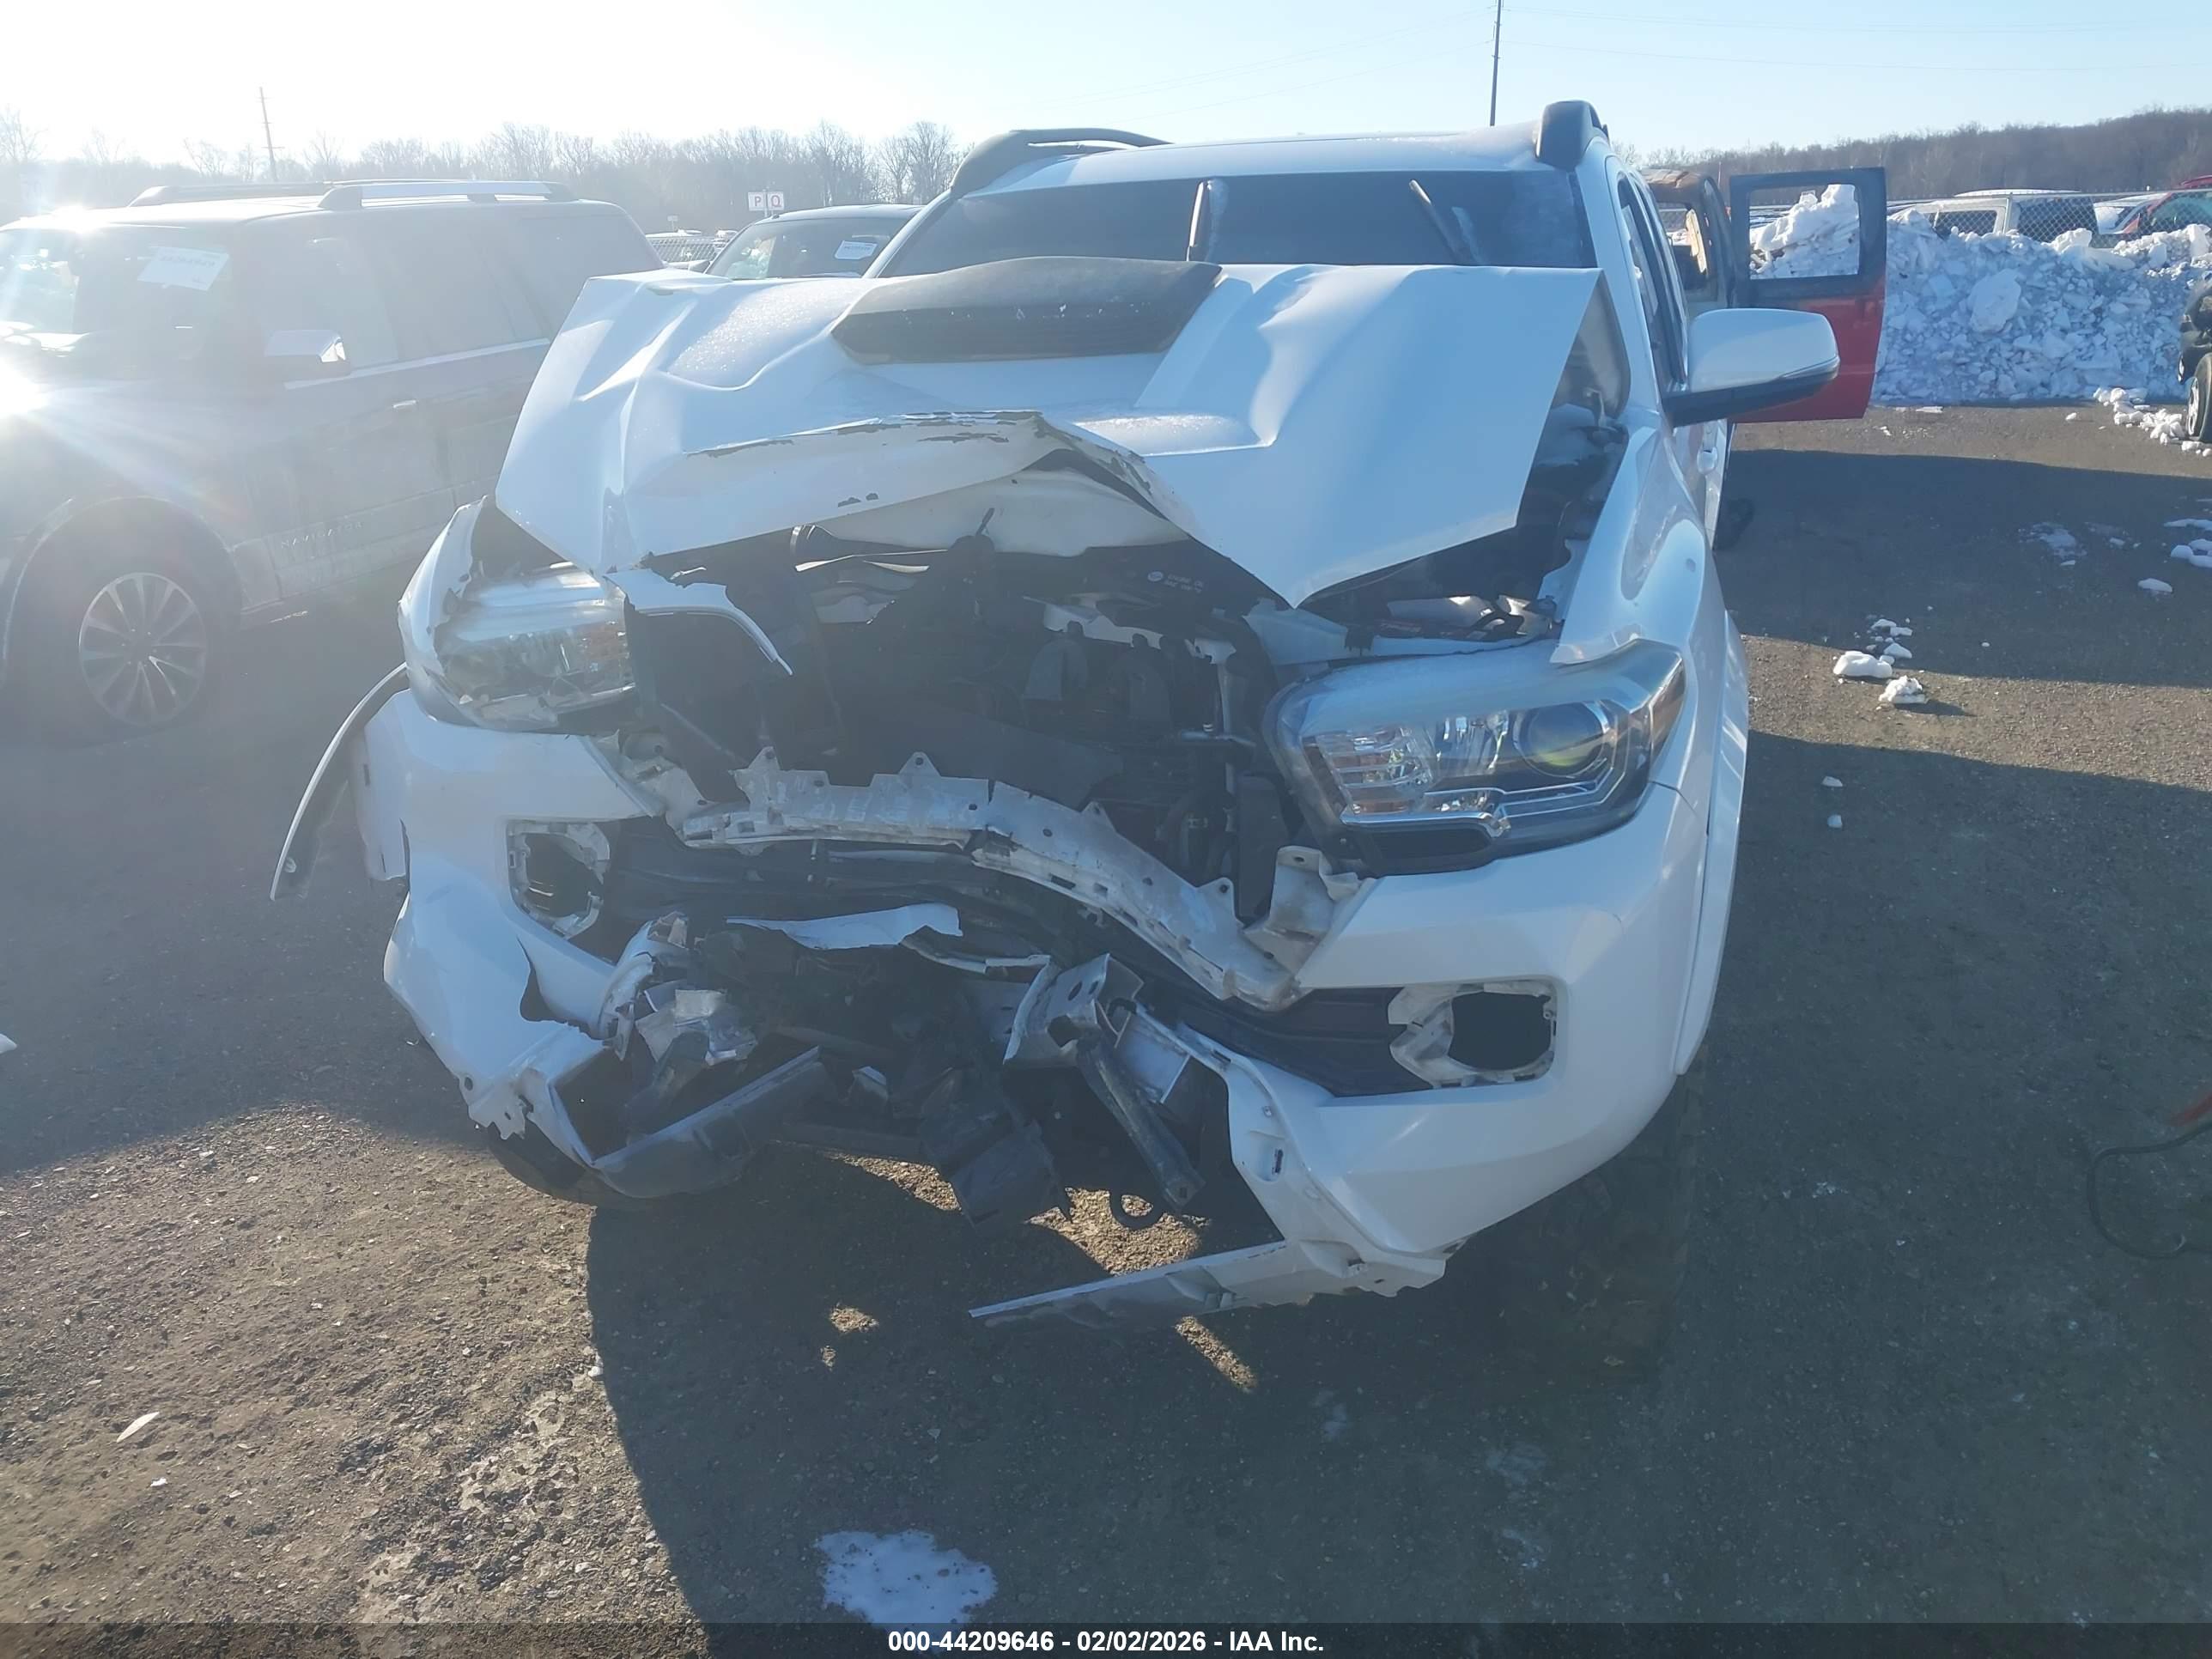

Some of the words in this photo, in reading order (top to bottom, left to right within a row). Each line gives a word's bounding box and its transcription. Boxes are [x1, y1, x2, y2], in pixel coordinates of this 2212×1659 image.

[754, 196, 763, 207] P
[770, 194, 782, 208] Q
[281, 521, 363, 549] NAVIGATOR
